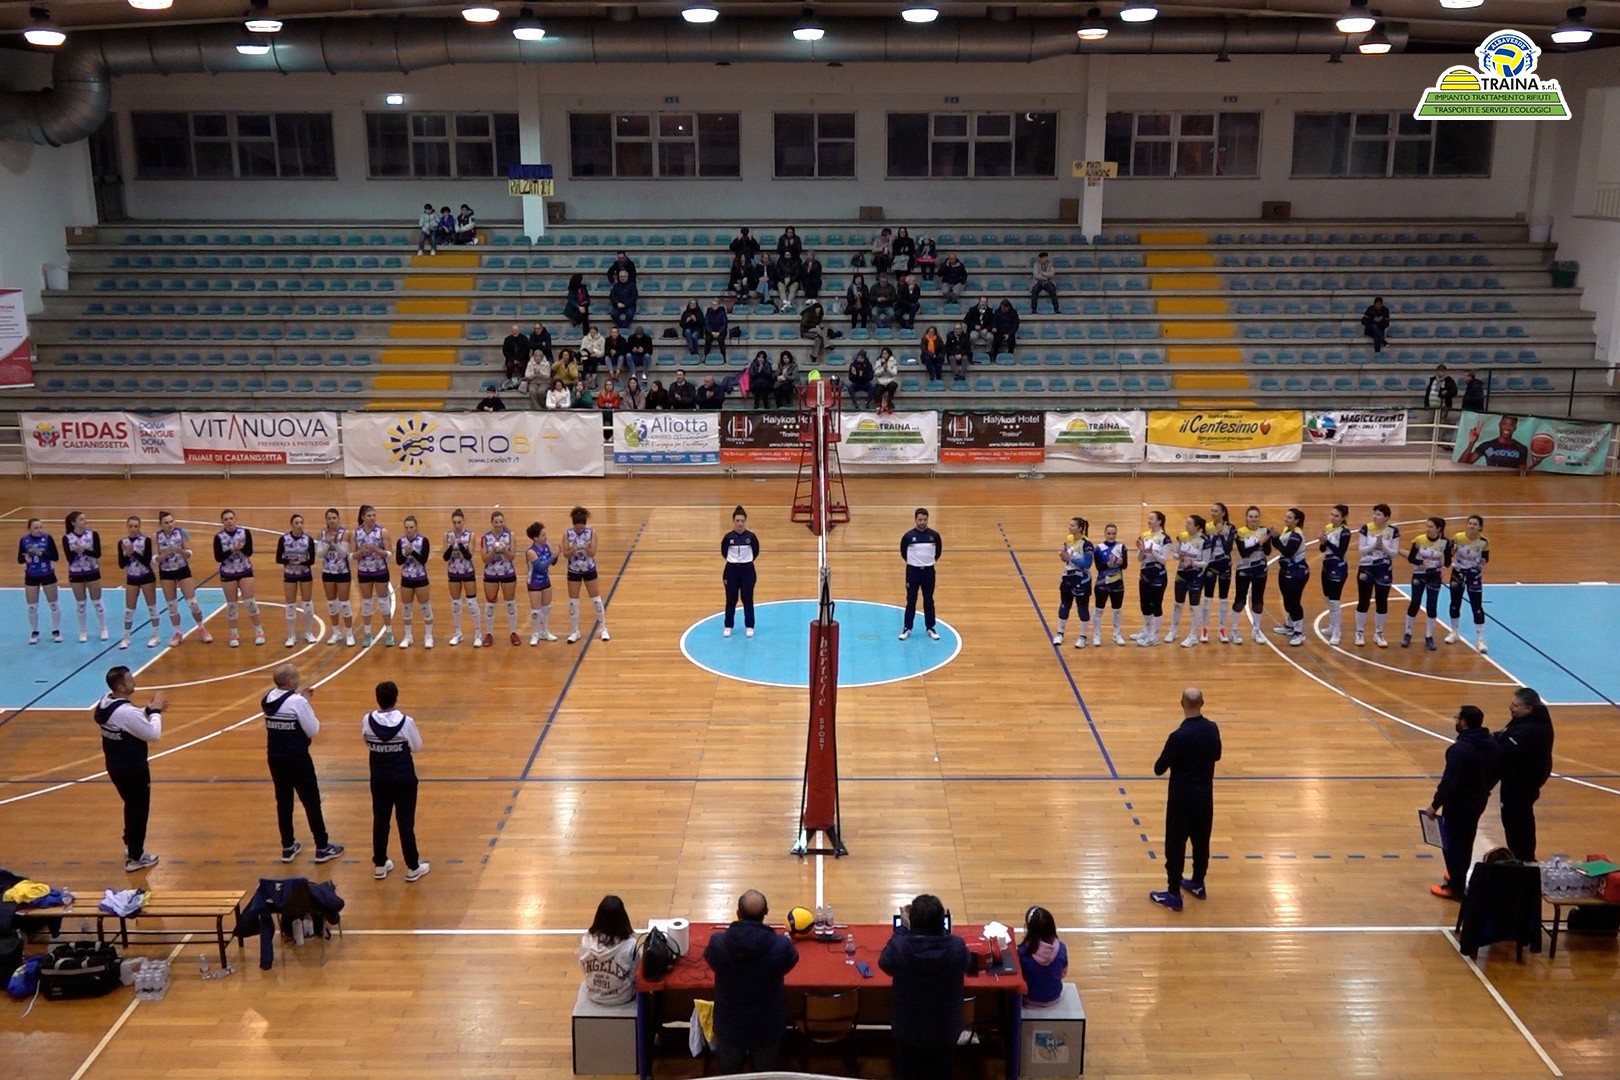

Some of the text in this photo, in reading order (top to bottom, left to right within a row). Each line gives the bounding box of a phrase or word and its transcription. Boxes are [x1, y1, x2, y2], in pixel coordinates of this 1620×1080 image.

[651, 417, 708, 433] Aliotta
[762, 415, 796, 425] Halykos
[982, 415, 1040, 425] Halykos Hotel
[1179, 415, 1258, 433] il Centesimo
[61, 422, 127, 439] FIDAS
[1088, 422, 1120, 430] TRAINA
[139, 430, 174, 438] SANGUE
[63, 441, 130, 449] CALTANISSETTA
[188, 453, 214, 461] FILIALE
[224, 453, 283, 461] CALTANISSETTA
[818, 717, 826, 750] SPORT
[592, 978, 611, 988] 1991
